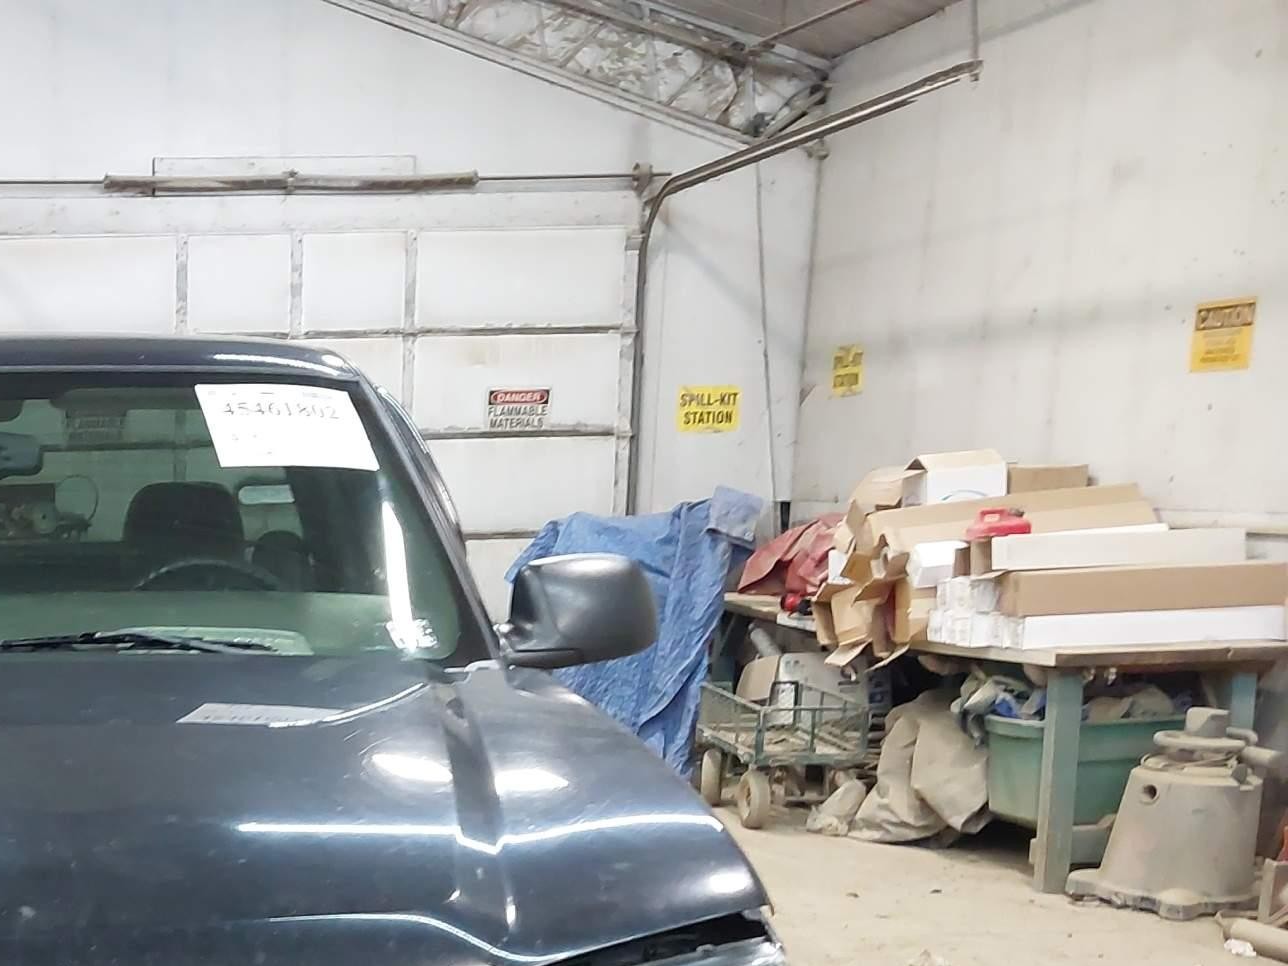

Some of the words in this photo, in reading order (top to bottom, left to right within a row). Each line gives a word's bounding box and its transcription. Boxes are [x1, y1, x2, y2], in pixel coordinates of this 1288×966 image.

[497, 392, 544, 403] DANGER
[680, 392, 739, 408] SPILL-KIT
[488, 405, 548, 417] FLAMMABLE
[683, 410, 733, 425] STATION
[489, 417, 544, 430] MATERIALS
